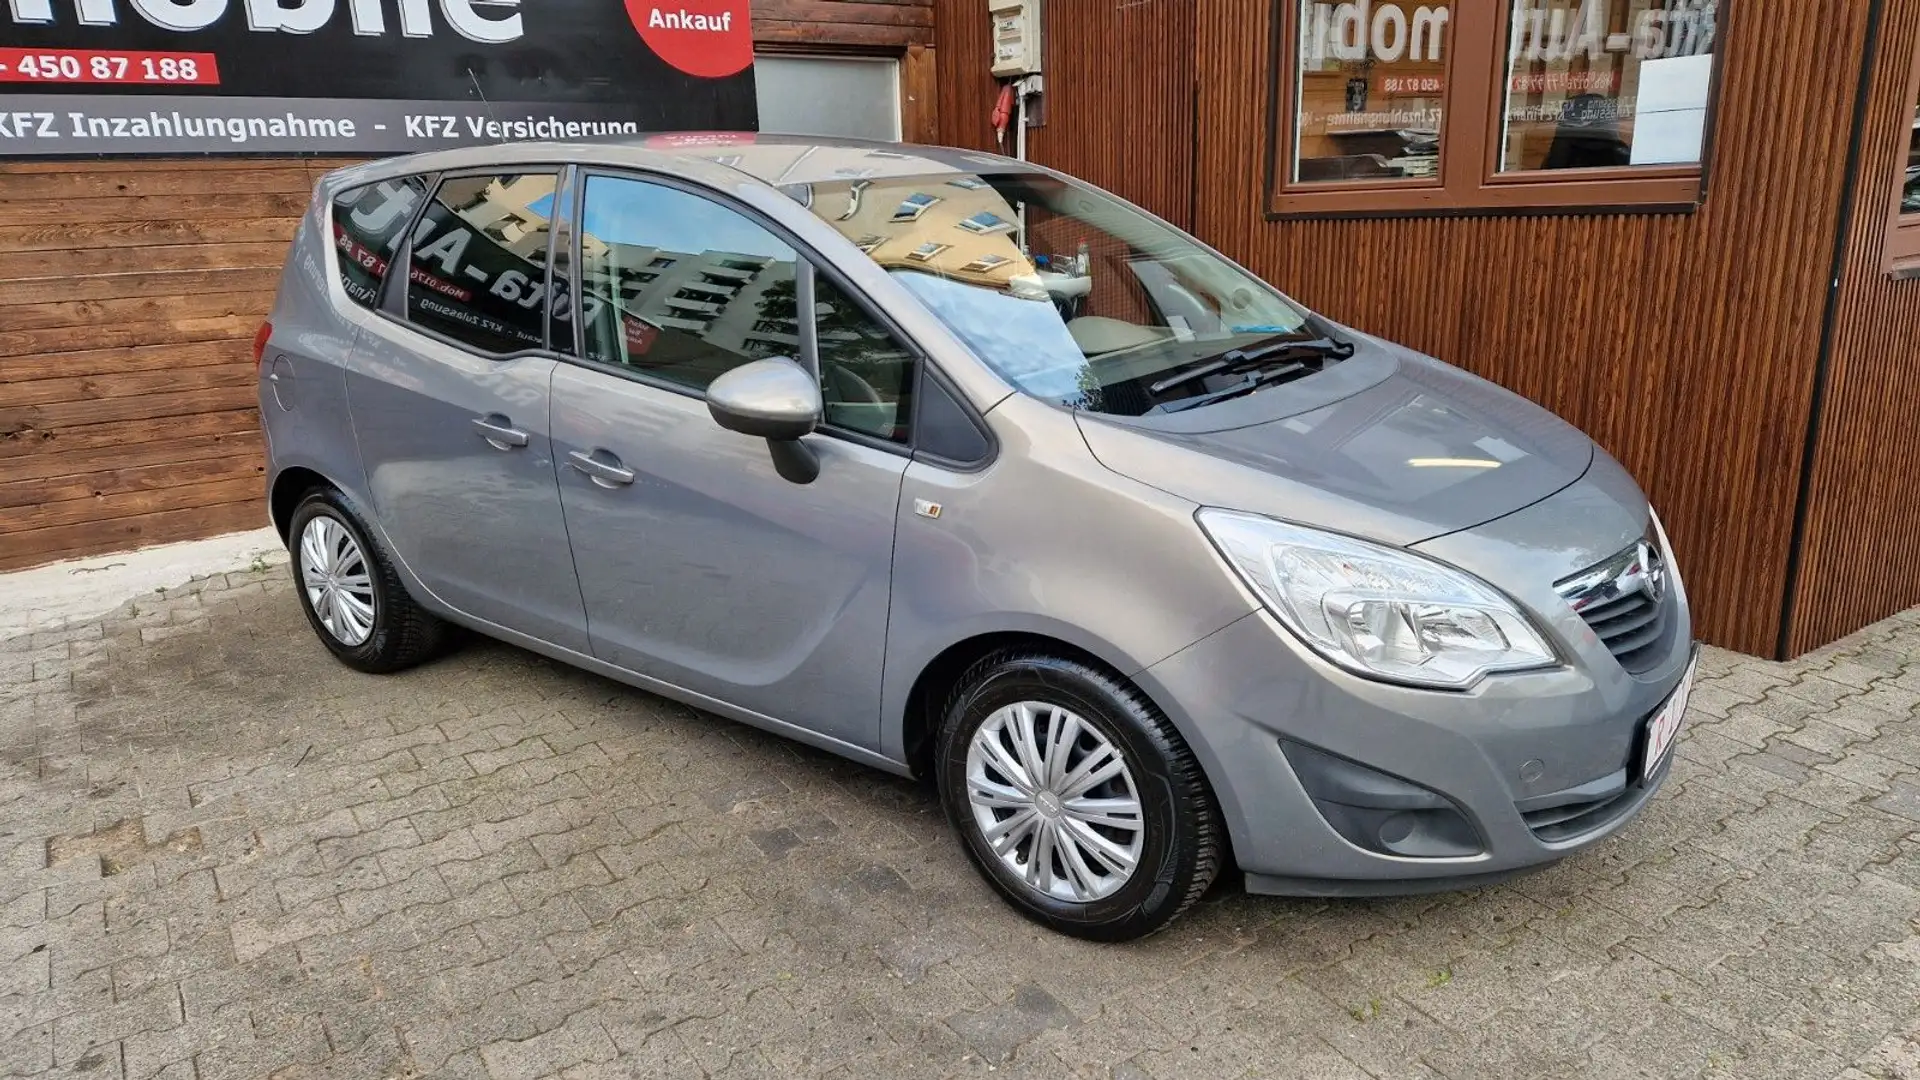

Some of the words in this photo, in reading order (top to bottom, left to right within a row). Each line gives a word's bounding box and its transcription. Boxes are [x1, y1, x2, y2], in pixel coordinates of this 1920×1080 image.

[649, 8, 731, 31] Ankauf
[17, 55, 82, 79] 450
[89, 56, 129, 80] 87
[141, 57, 198, 81] 188
[69, 111, 356, 143] Inzahlungnahme
[404, 115, 460, 138] KFZ
[465, 116, 638, 139] Versicherung
